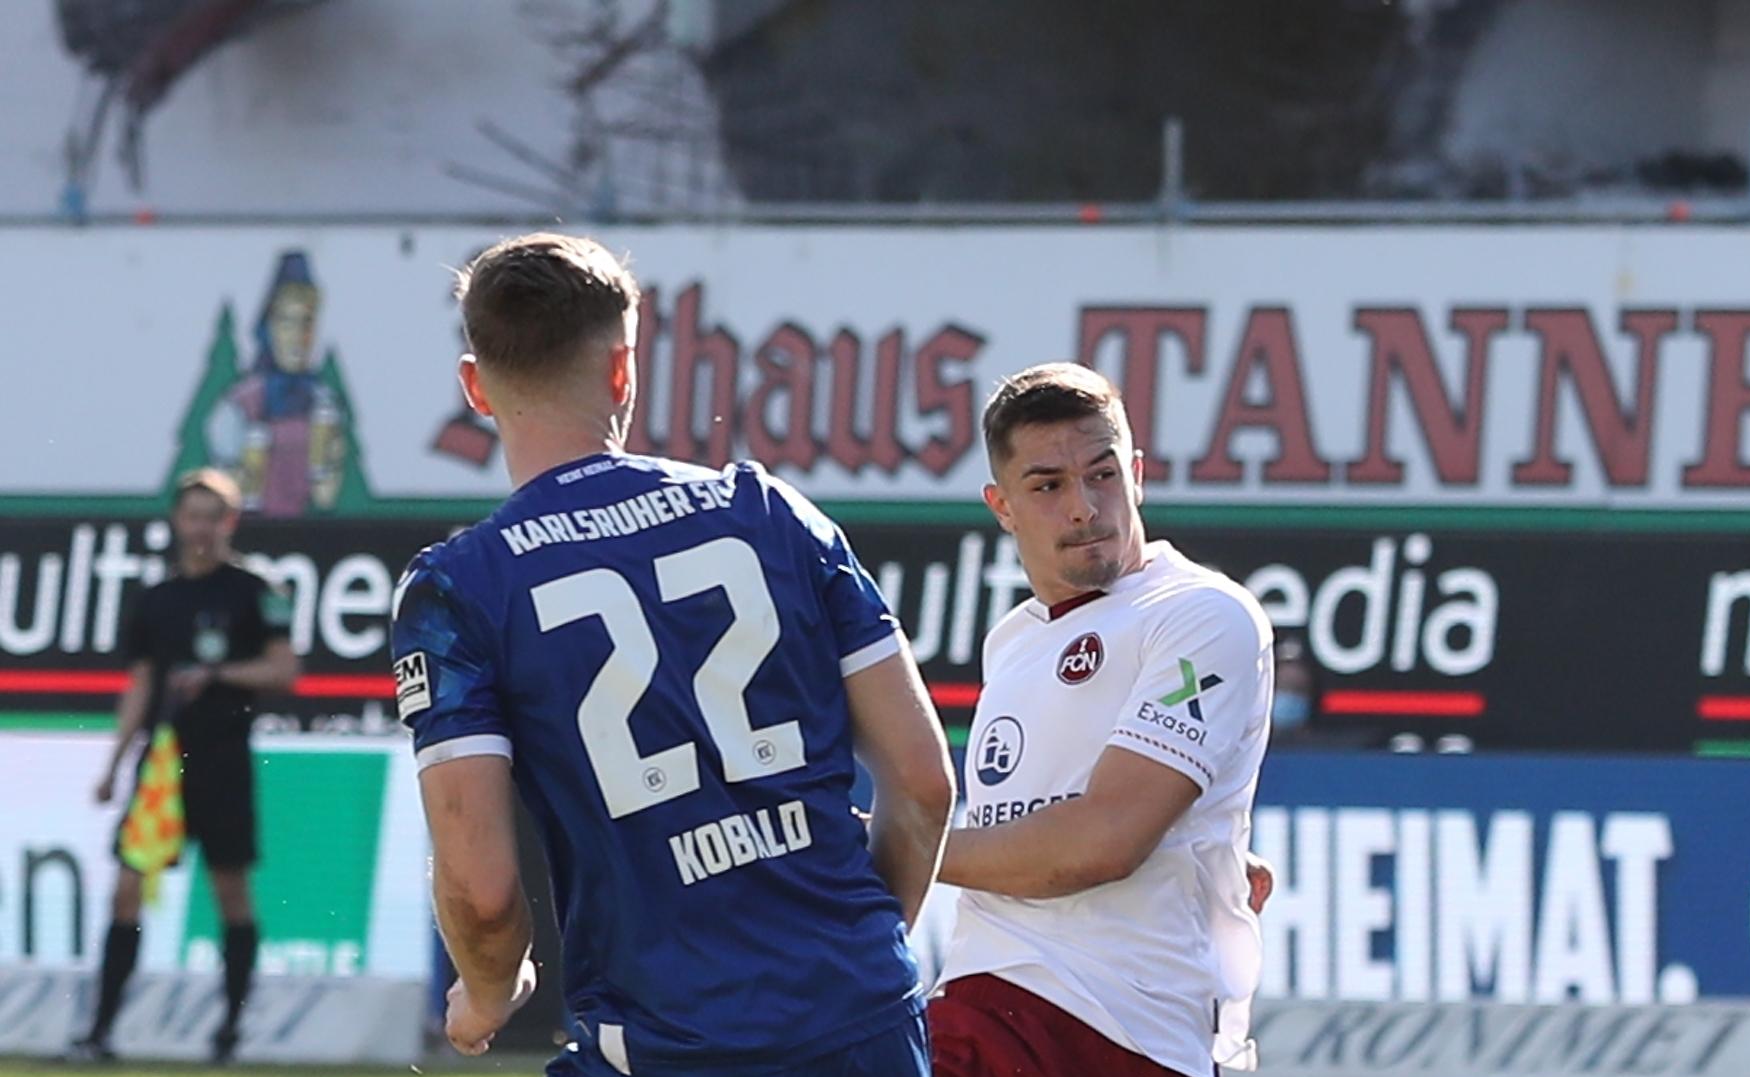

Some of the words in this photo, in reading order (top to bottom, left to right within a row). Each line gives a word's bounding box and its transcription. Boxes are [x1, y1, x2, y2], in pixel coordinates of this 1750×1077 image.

[500, 483, 697, 556] KARLSRUHER
[529, 537, 807, 819] 22
[1060, 651, 1097, 673] FCN
[1136, 701, 1208, 747] Exasol
[1255, 806, 1699, 1003] HEIMAT.
